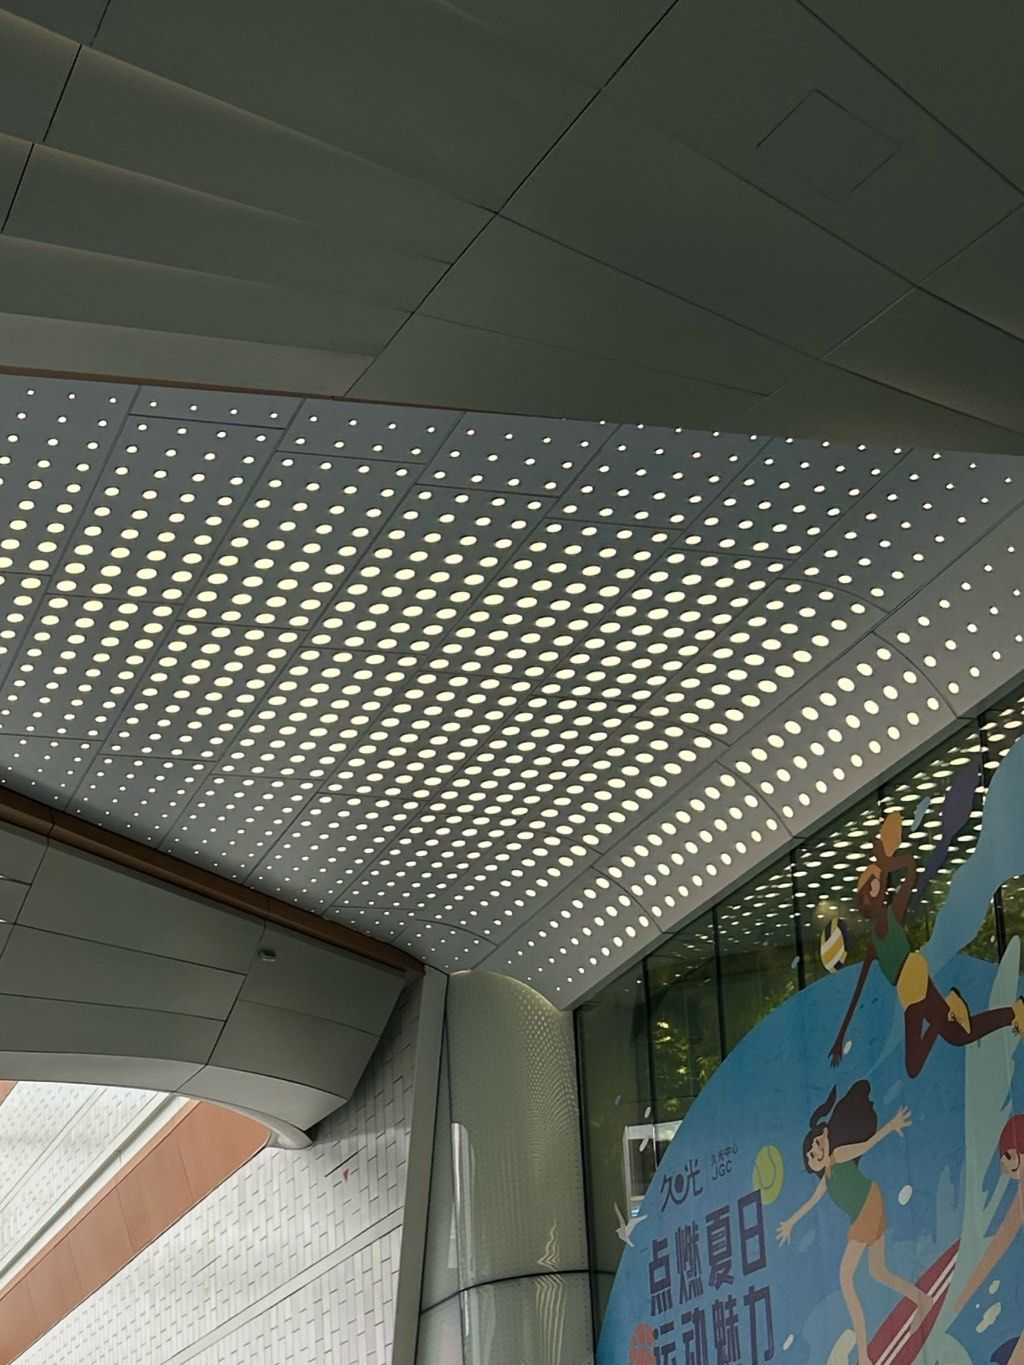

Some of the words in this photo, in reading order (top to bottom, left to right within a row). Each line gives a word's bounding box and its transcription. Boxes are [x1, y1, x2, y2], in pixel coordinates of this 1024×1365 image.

[712, 1159, 733, 1181] JGC
[648, 1188, 767, 1317] 点燃夏日
